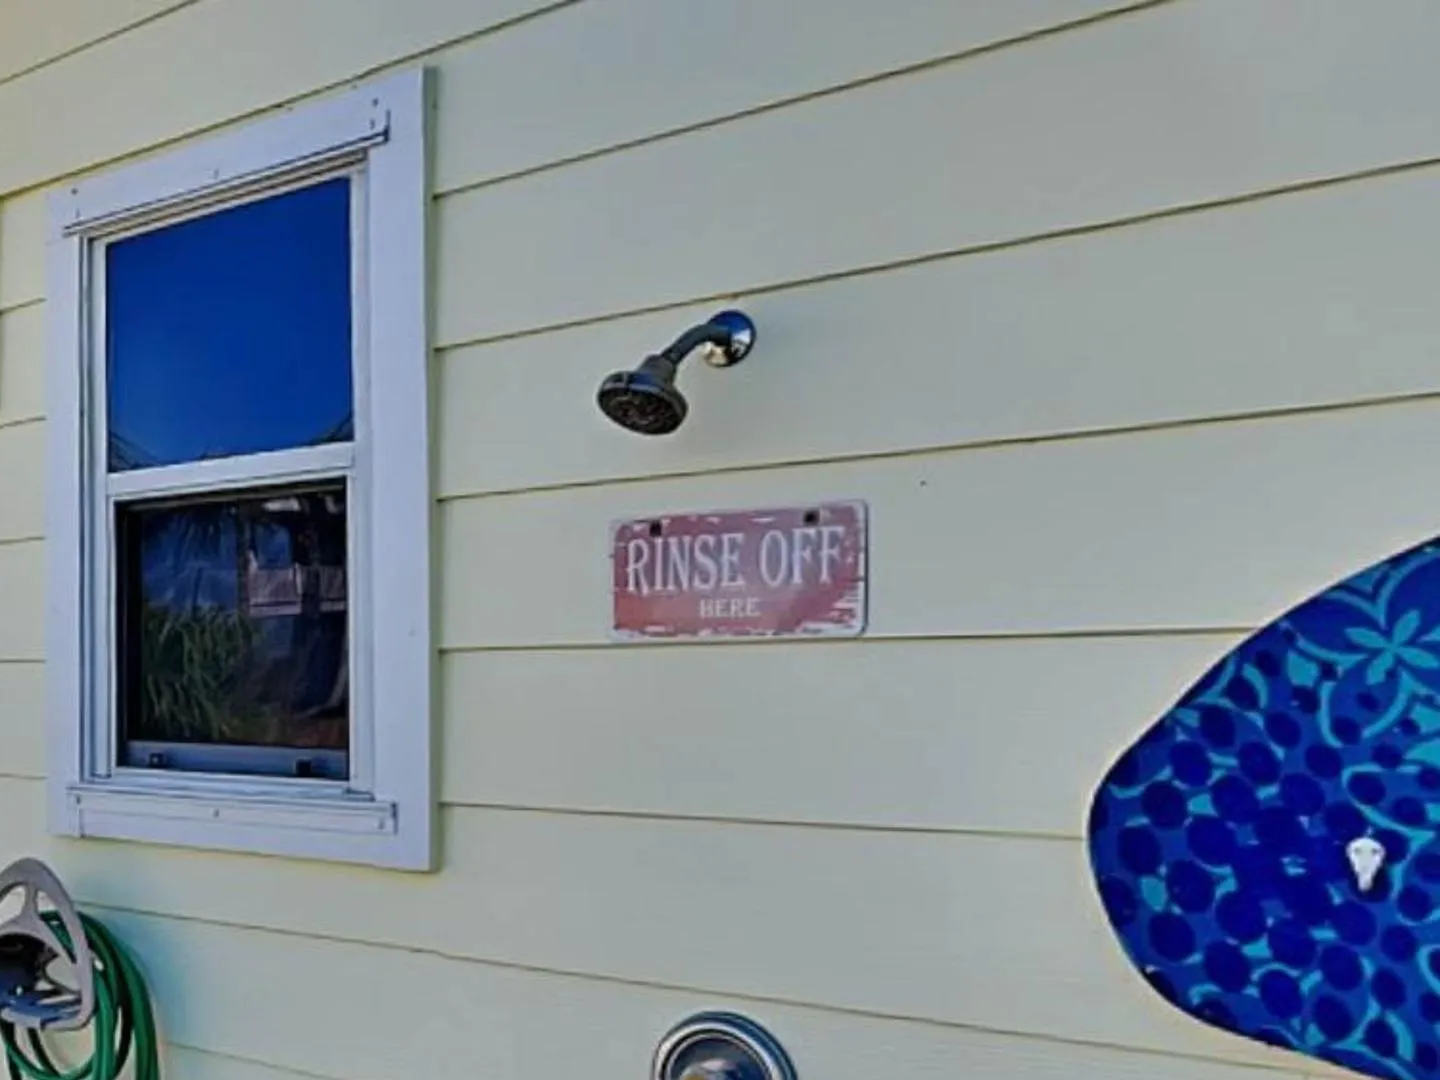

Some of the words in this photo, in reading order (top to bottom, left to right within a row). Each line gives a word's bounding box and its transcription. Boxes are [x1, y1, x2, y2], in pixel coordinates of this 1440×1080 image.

[626, 532, 746, 596] RINSE
[759, 525, 846, 587] OFF
[699, 596, 760, 619] HERE
